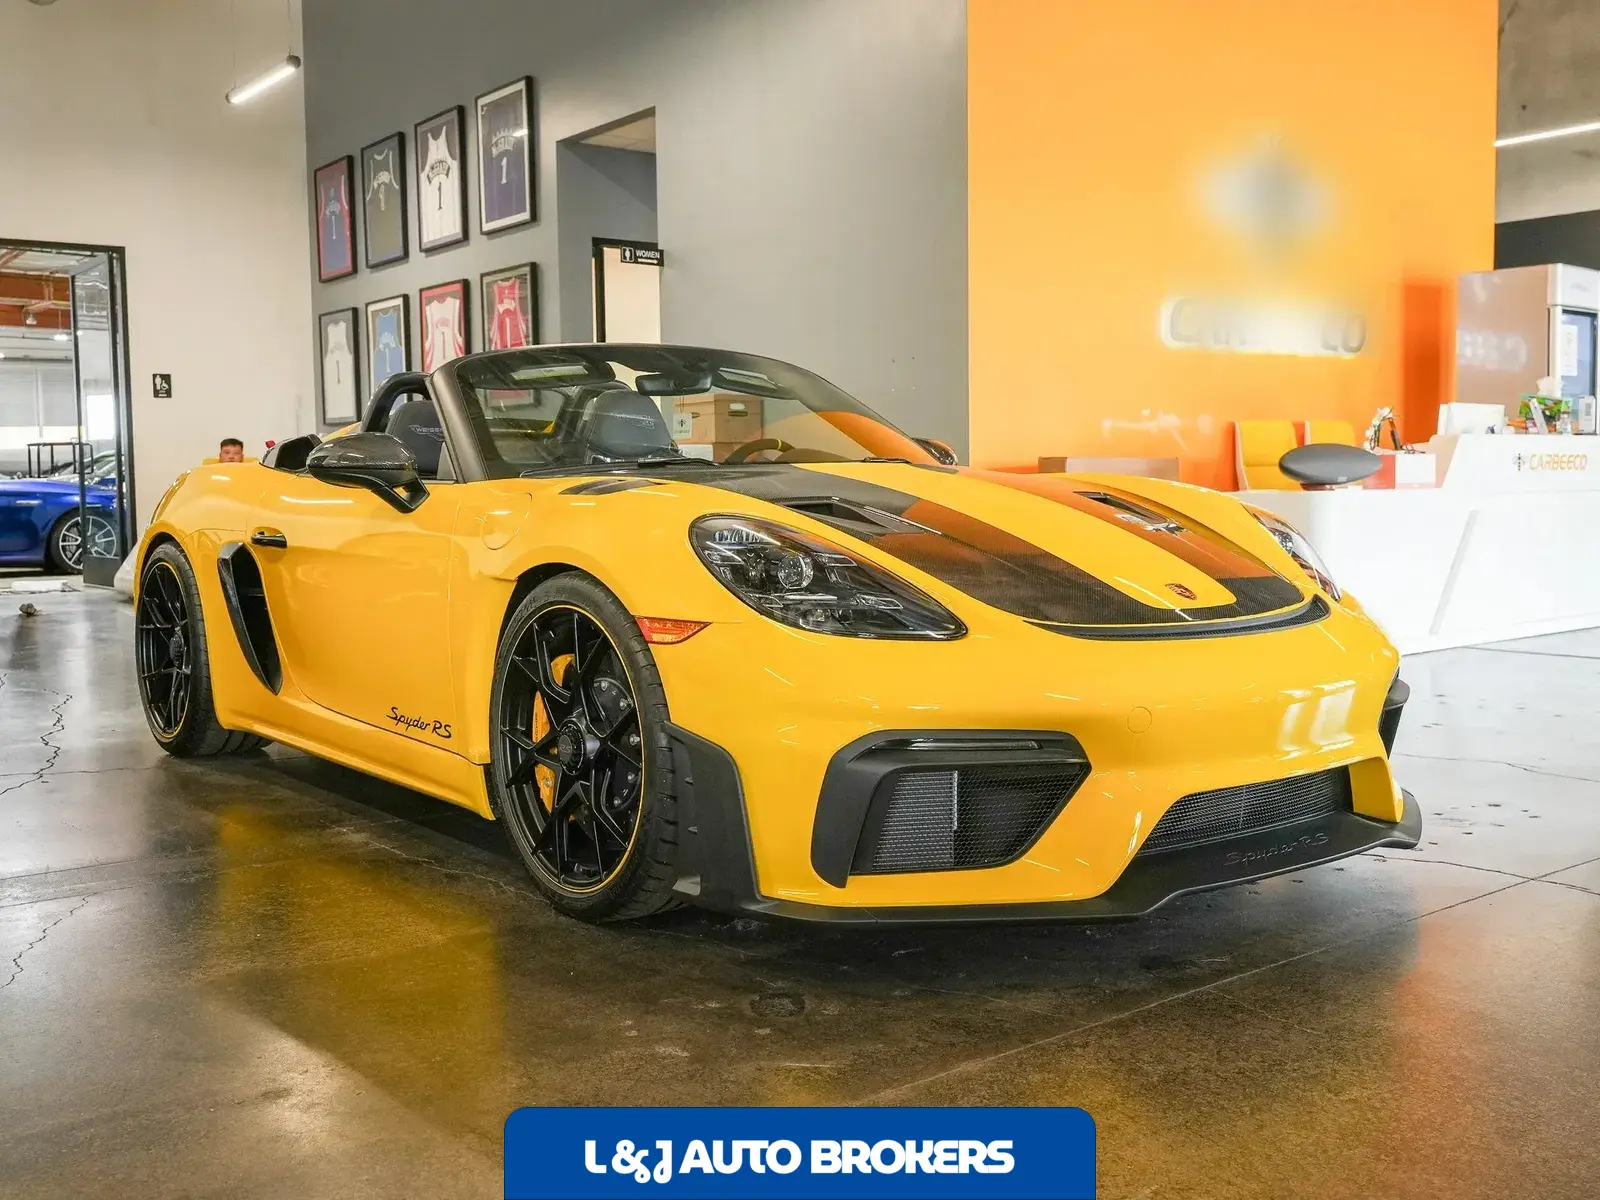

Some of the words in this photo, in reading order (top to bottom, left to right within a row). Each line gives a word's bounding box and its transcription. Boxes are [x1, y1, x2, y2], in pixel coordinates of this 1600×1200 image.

[501, 157, 507, 184] 1
[437, 182, 443, 211] 1
[635, 249, 660, 259] WOMEN
[1529, 453, 1588, 471] CARBEECO
[386, 706, 430, 731] Spyder
[431, 720, 452, 739] RS
[1223, 842, 1298, 867] Spyder
[1299, 832, 1329, 849] RS
